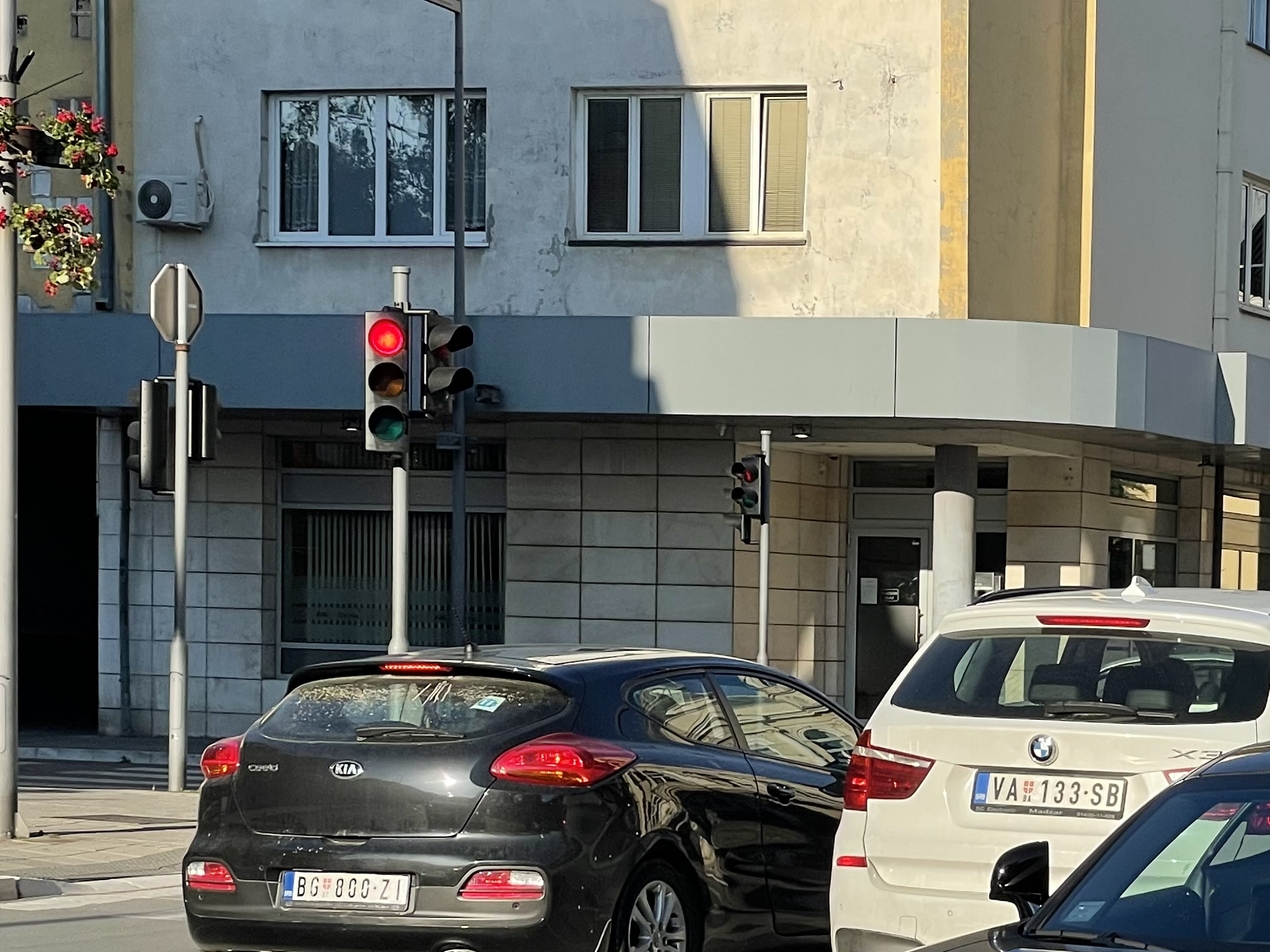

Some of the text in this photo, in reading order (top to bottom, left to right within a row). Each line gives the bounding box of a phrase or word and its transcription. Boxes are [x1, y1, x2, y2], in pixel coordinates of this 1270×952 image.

[1167, 748, 1223, 760] X3
[334, 763, 357, 775] KIA
[993, 776, 1018, 801] VA
[297, 876, 320, 897] BG
